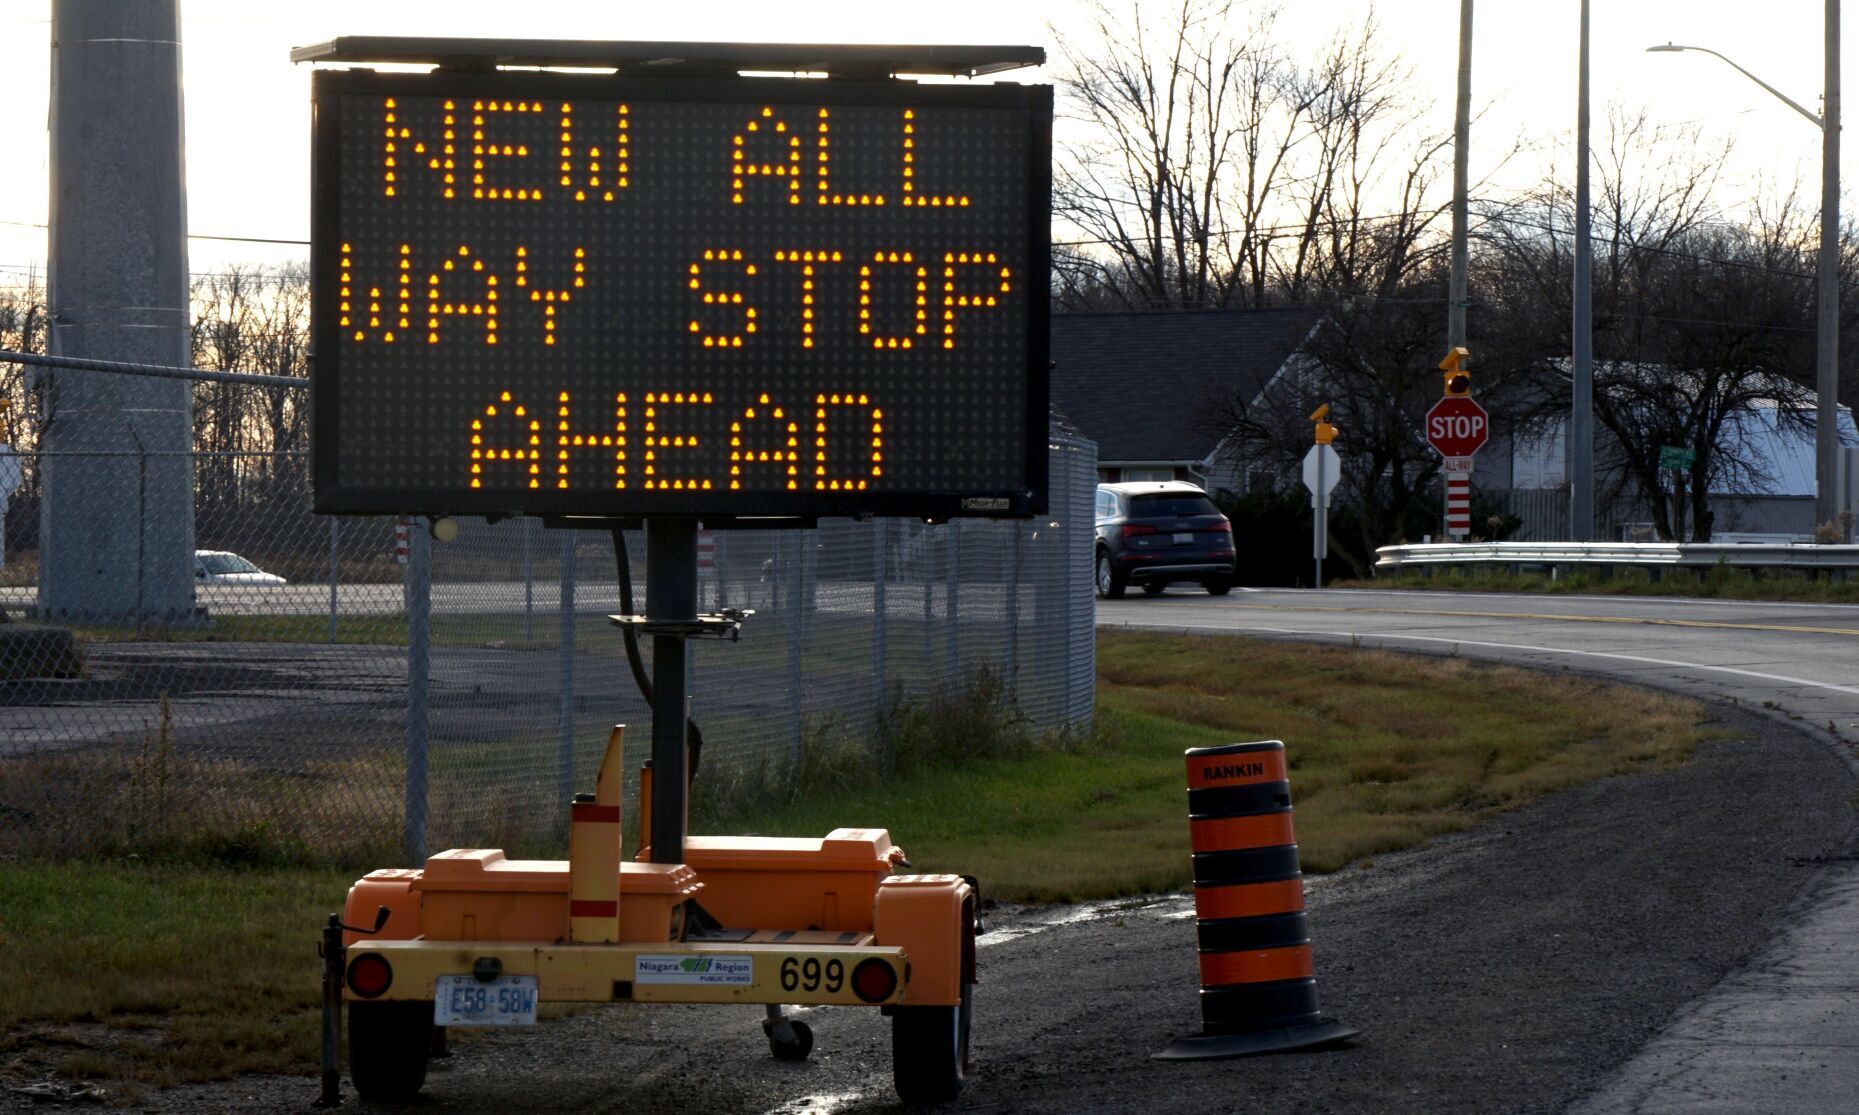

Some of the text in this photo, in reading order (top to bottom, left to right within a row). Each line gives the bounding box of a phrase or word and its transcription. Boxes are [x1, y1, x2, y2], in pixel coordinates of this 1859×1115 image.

[384, 98, 969, 206] NEW ALL
[340, 243, 1010, 349] WAY STOP
[470, 391, 882, 490] AHEAD
[1431, 415, 1484, 439] STOP
[1203, 762, 1264, 780] RANKIN
[639, 962, 749, 974] Niagara Region
[725, 975, 751, 983] WORKS
[780, 956, 844, 993] 699
